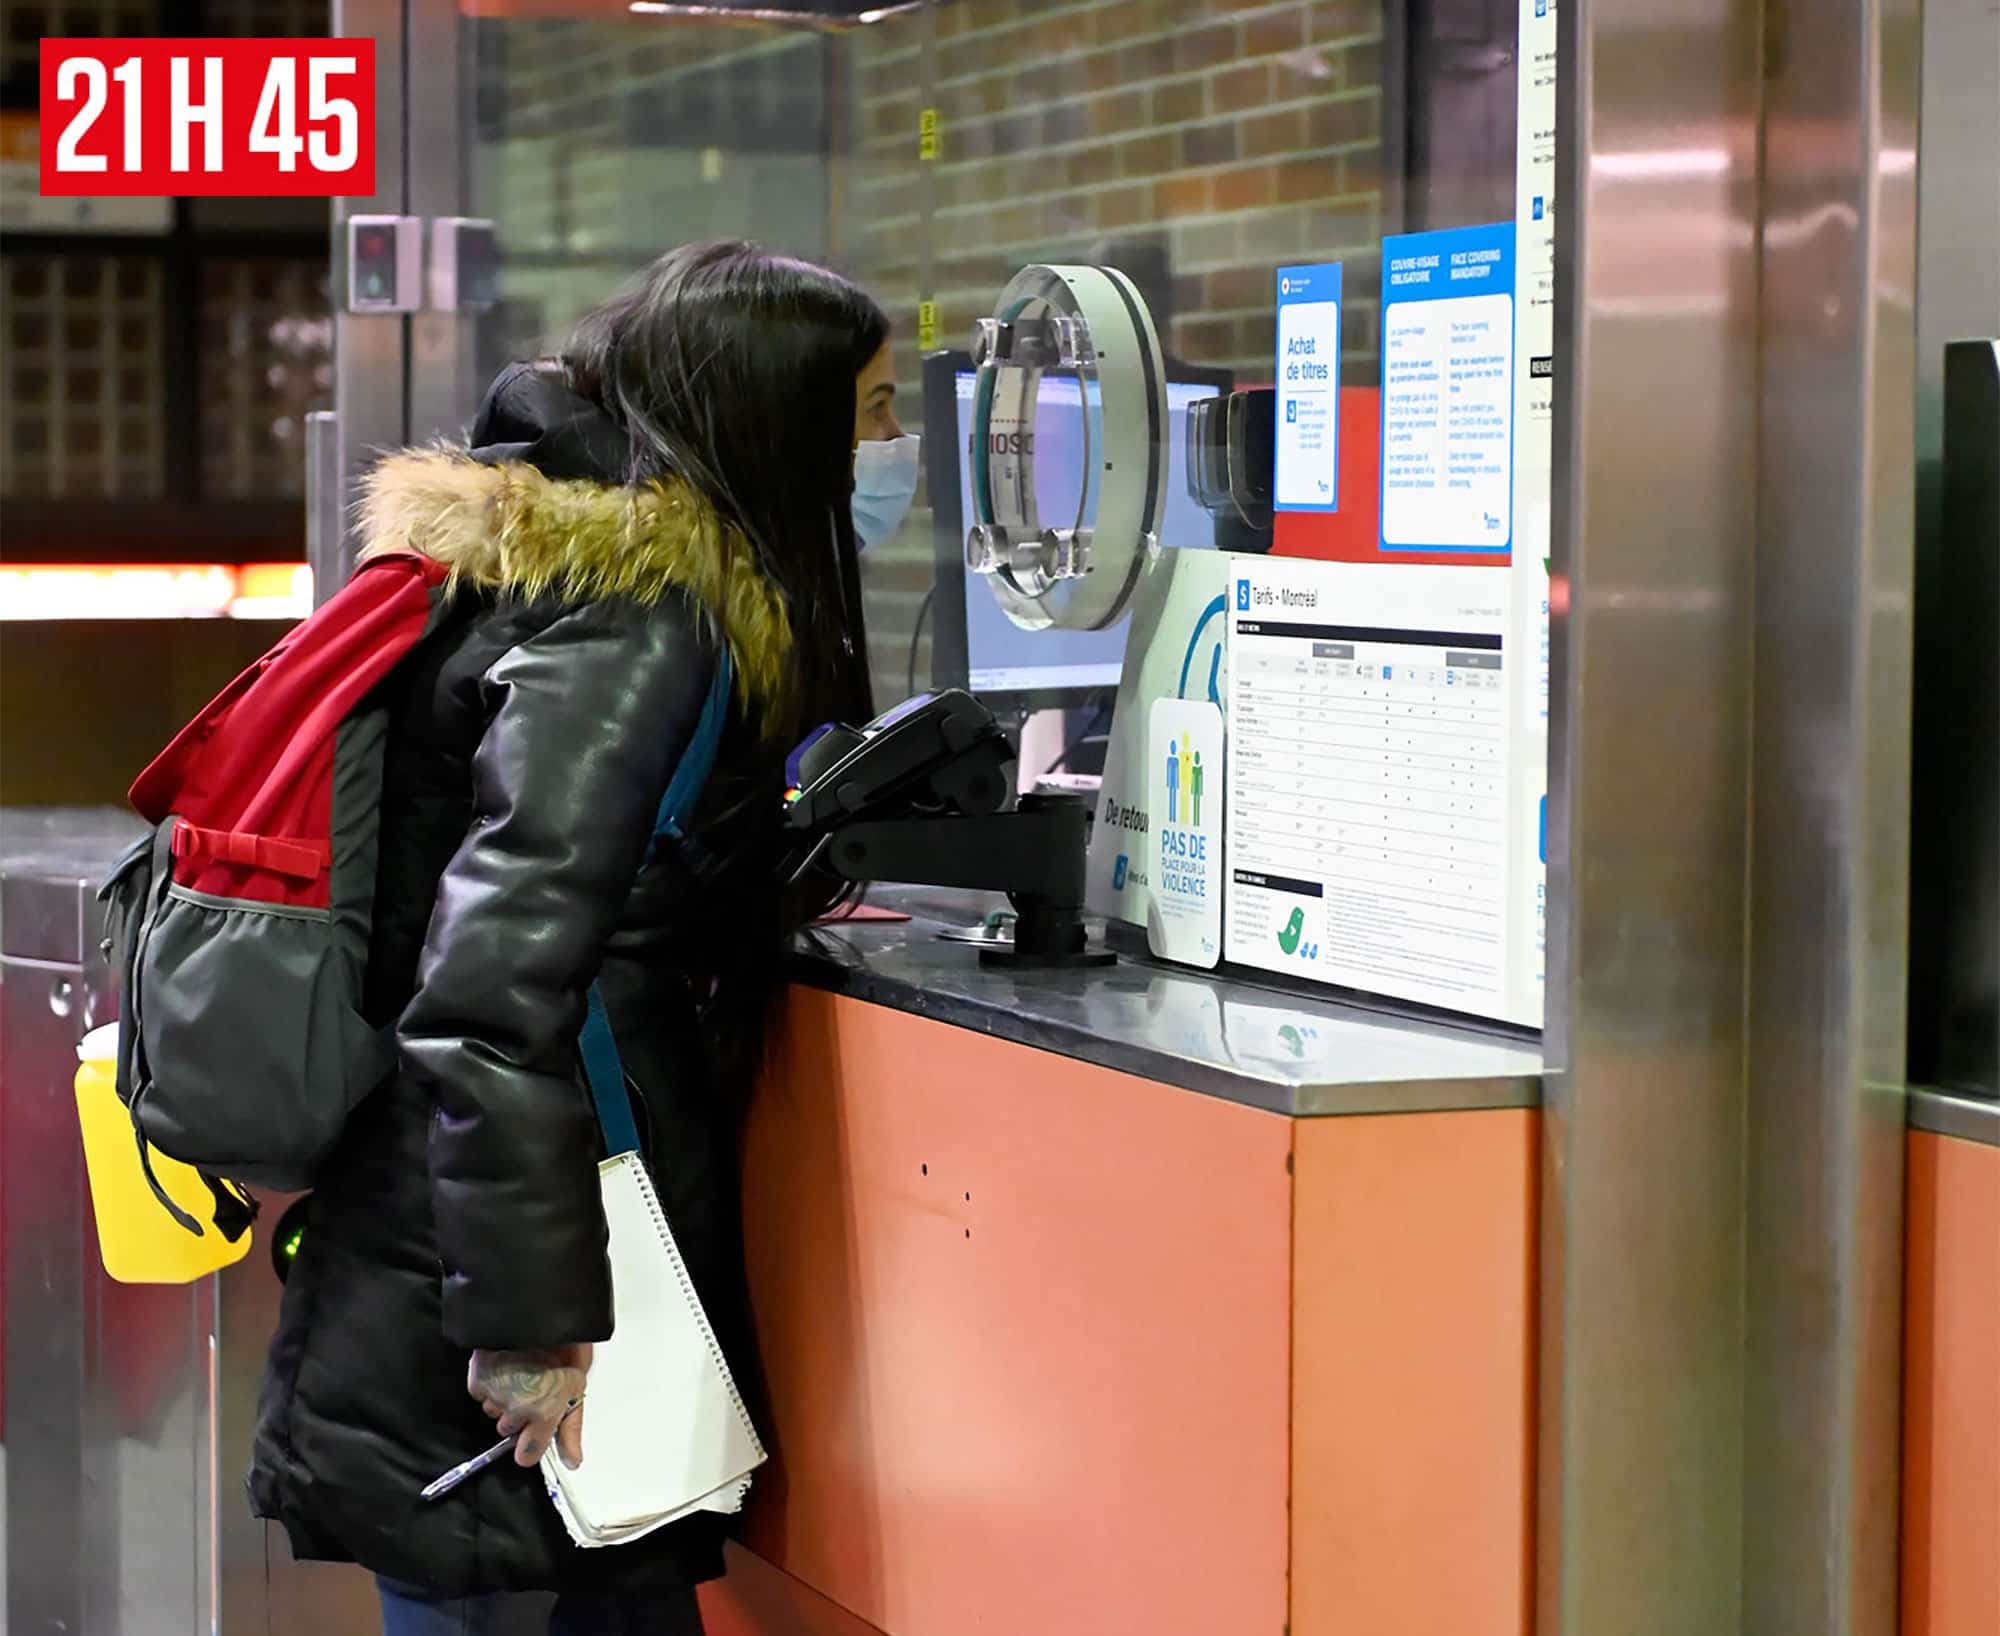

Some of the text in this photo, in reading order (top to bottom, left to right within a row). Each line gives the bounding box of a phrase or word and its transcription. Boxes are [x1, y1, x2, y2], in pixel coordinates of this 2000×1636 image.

[1450, 252, 1467, 265] FACE
[1287, 335, 1316, 356] Achat
[1286, 360, 1328, 380] de titres
[1252, 586, 1318, 607] Tarifs Montréal
[1105, 798, 1119, 825] De
[1162, 830, 1206, 860] PAS DE
[1162, 873, 1206, 897] VIOLENCE
